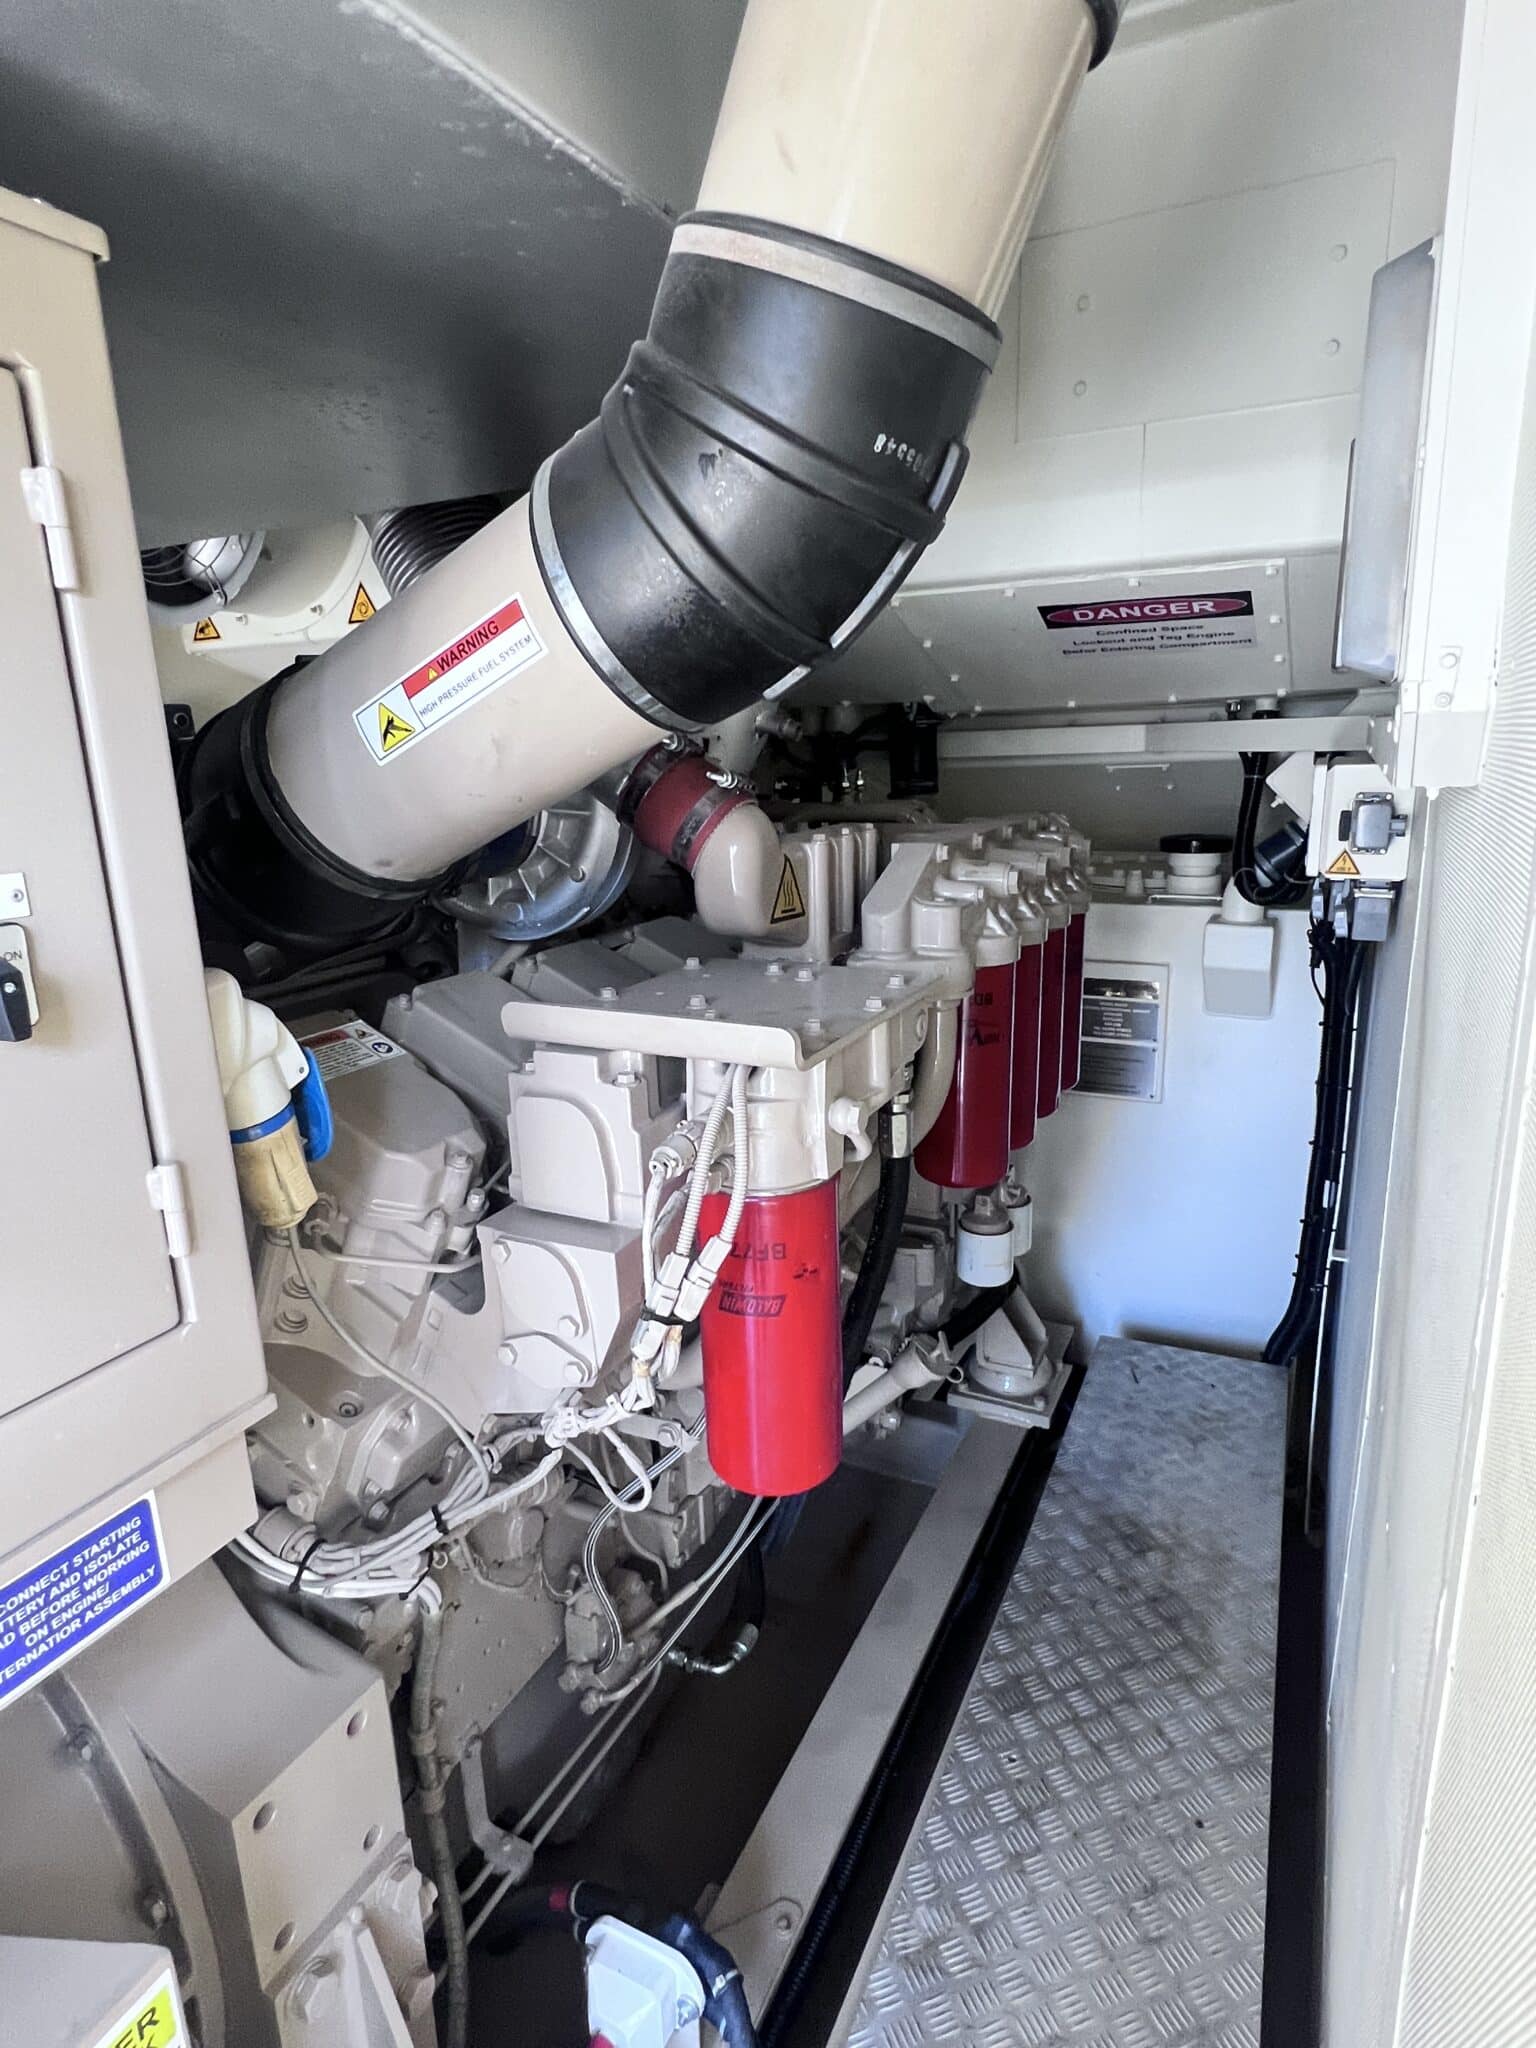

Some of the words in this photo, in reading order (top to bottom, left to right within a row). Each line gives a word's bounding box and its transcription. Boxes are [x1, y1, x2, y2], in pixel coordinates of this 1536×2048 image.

[1072, 600, 1217, 622] DANGER
[1096, 627, 1156, 636] Confined
[1162, 625, 1205, 633] Space
[436, 620, 500, 672] WARNING
[1073, 638, 1125, 646] Lockout
[1130, 635, 1154, 643] and
[1160, 634, 1182, 642] Tag
[1187, 631, 1235, 640] Engine
[1101, 644, 1155, 653] Entering
[1160, 638, 1252, 650] Compartment
[419, 700, 438, 717] HIGH
[438, 672, 477, 704] PRESSURE
[478, 658, 500, 676] FUEL
[499, 634, 532, 662] SYSTEM
[4, 949, 22, 961] ON
[720, 1293, 782, 1315] BALDWIN
[49, 1573, 81, 1602] AND
[83, 1530, 142, 1576] ISOLATE
[73, 1515, 142, 1568] STARTING
[19, 1588, 82, 1636] BEFORE
[83, 1541, 151, 1592] WORKING
[24, 1625, 49, 1648] ON
[51, 1581, 110, 1629] ENGINE/
[84, 1564, 156, 1624] ASSEMBLY
